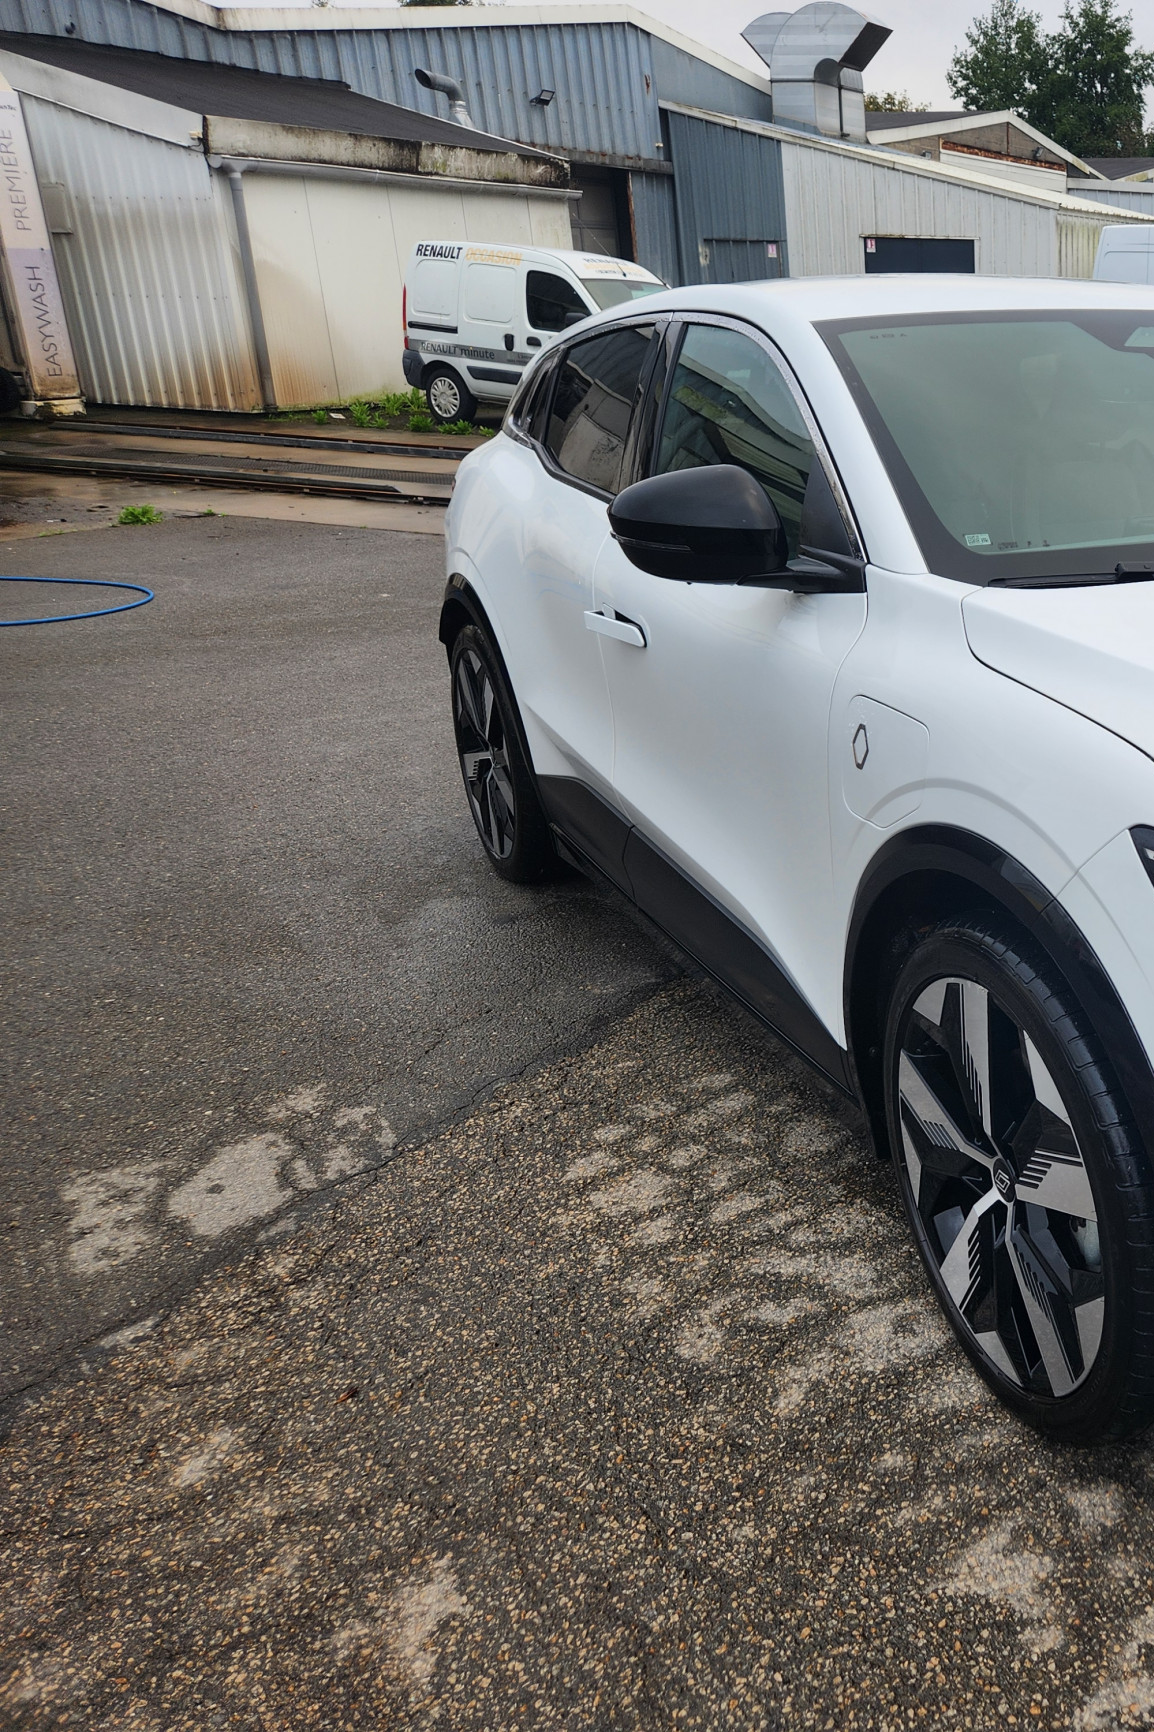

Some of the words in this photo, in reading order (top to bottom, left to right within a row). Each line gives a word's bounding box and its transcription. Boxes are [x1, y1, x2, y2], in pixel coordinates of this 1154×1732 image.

[416, 244, 463, 260] RENAULT
[466, 247, 523, 266] OCCASION
[25, 266, 62, 378] EASYWASH
[420, 341, 458, 355] RENAULT
[460, 346, 495, 360] minute
